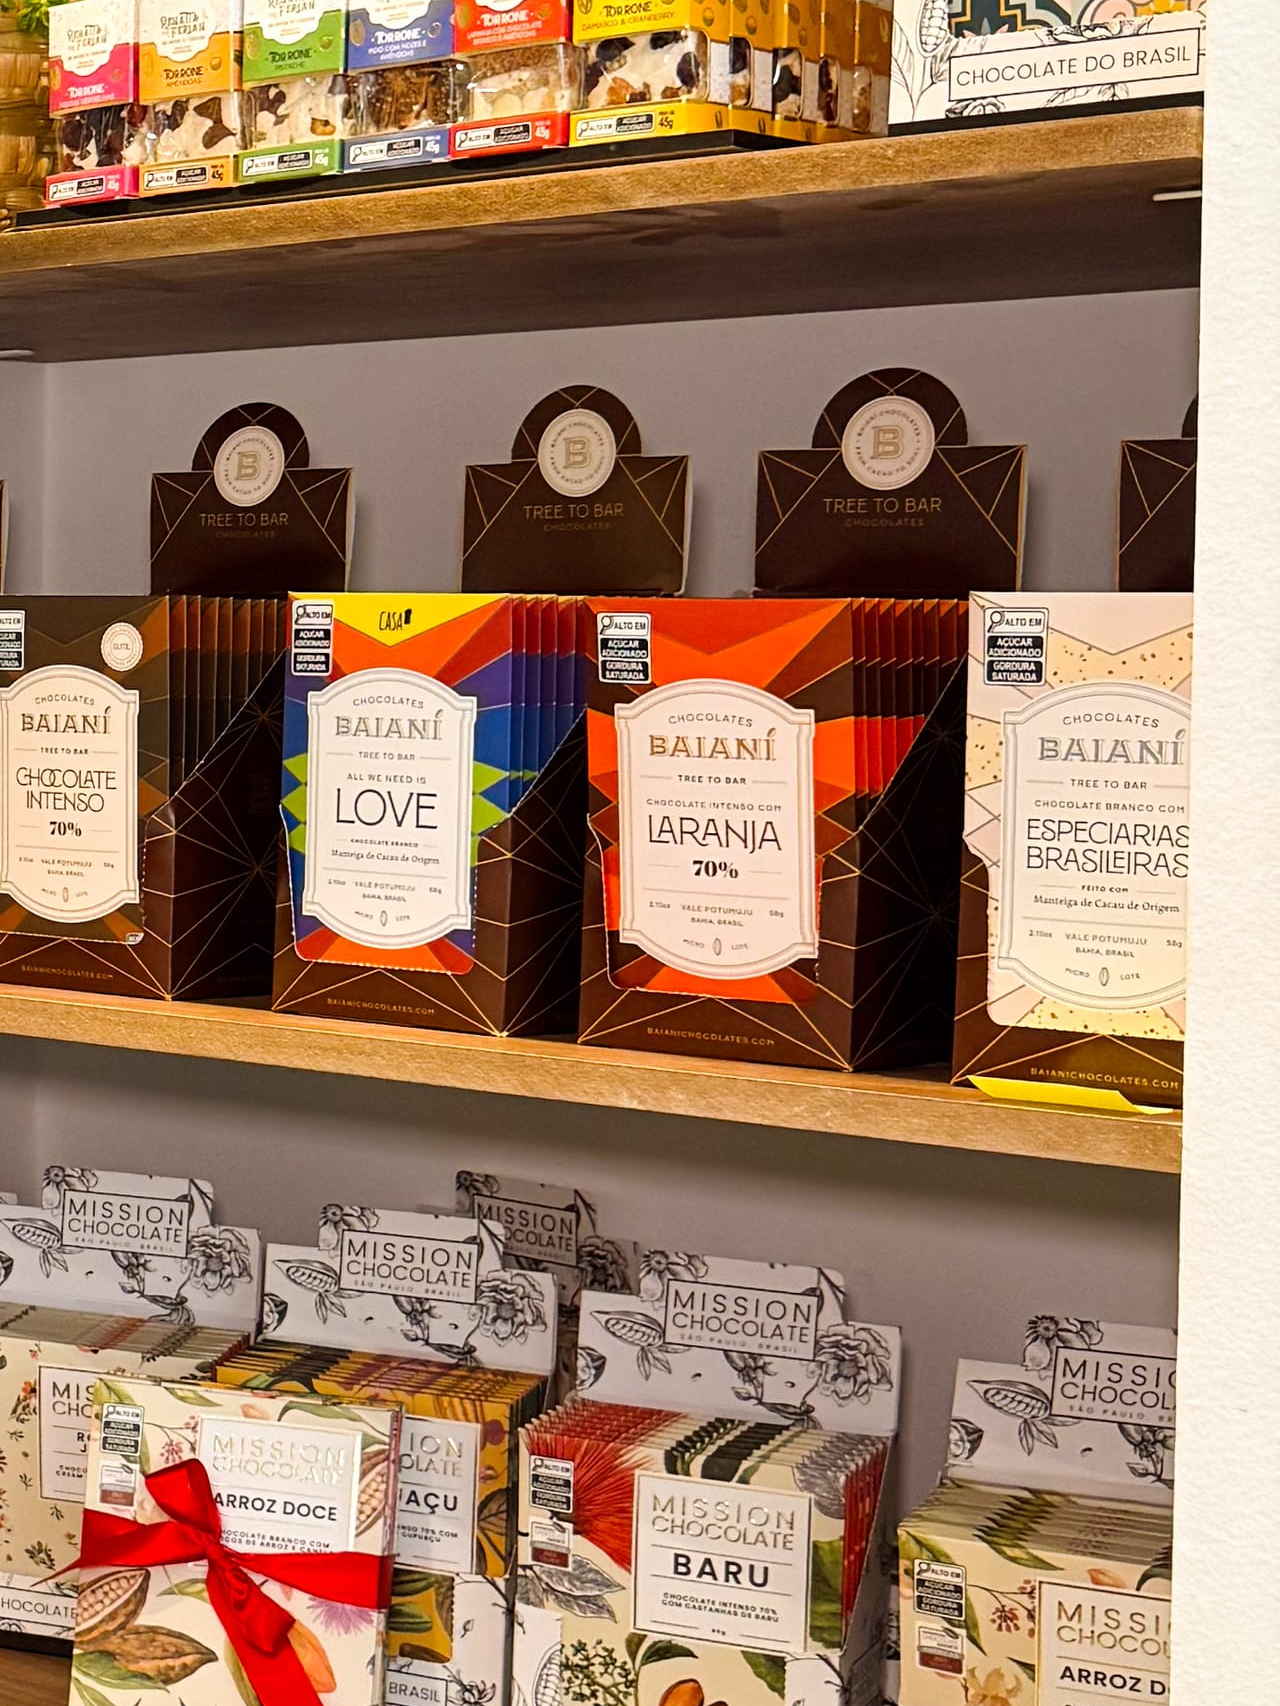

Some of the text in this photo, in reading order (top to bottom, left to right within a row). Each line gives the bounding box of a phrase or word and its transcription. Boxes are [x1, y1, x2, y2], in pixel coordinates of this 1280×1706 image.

[480, 11, 529, 27] TORRONE
[603, 2, 652, 18] TORRONE
[956, 46, 1191, 86] CHOCOLATE DO BRASIL
[523, 503, 624, 519] TREE TO BAR
[822, 498, 943, 513] TREE TO BAR
[200, 513, 289, 527] TREE TO BAR
[35, 694, 95, 707] CHOCOLATES
[352, 695, 424, 709] CHOCOLATES
[21, 707, 111, 735] BAIANÍ
[335, 709, 443, 741] BAIANÍ
[667, 713, 754, 727] CHOCOLATES
[1062, 713, 1160, 729] CHOCOLATES
[358, 751, 415, 762] TREE TO BAR
[648, 727, 777, 761] BAIANÍ
[16, 767, 116, 790] CHOCOLATE
[346, 773, 426, 784] ALL WE NEED IS
[678, 774, 746, 786] TREE TO BAR
[1070, 778, 1147, 790] TREE TO BAR
[25, 791, 105, 812] INTENSO
[336, 788, 439, 829] LOVE
[1034, 799, 1185, 814] CHOCOLATE BRANCO COM
[49, 820, 82, 837] 70%
[648, 814, 782, 855] LARANJA
[1026, 819, 1191, 848] ESPECIARIAS
[693, 859, 739, 880] 70%
[1026, 846, 1189, 879] BRASILEIRAS
[1033, 895, 1180, 916] Manteiga de Cacau de Origem
[68, 1198, 185, 1227] MISSION
[478, 1202, 574, 1235] MISSION
[67, 1217, 183, 1244] CHOCOLATE
[347, 1239, 473, 1269] MISSION
[346, 1260, 472, 1289] CHOCOLATE
[673, 1288, 811, 1324] MISSION
[672, 1312, 810, 1344] CHOCOLATE
[212, 1433, 345, 1468] MISSION
[212, 1456, 344, 1486] CHOCOLATE
[214, 1492, 337, 1522] ARROZ DOCE
[652, 1494, 795, 1532] MISSION
[652, 1515, 794, 1551] CHOCOLATE
[672, 1552, 769, 1588] BARU
[388, 1680, 441, 1703] BRASIL
